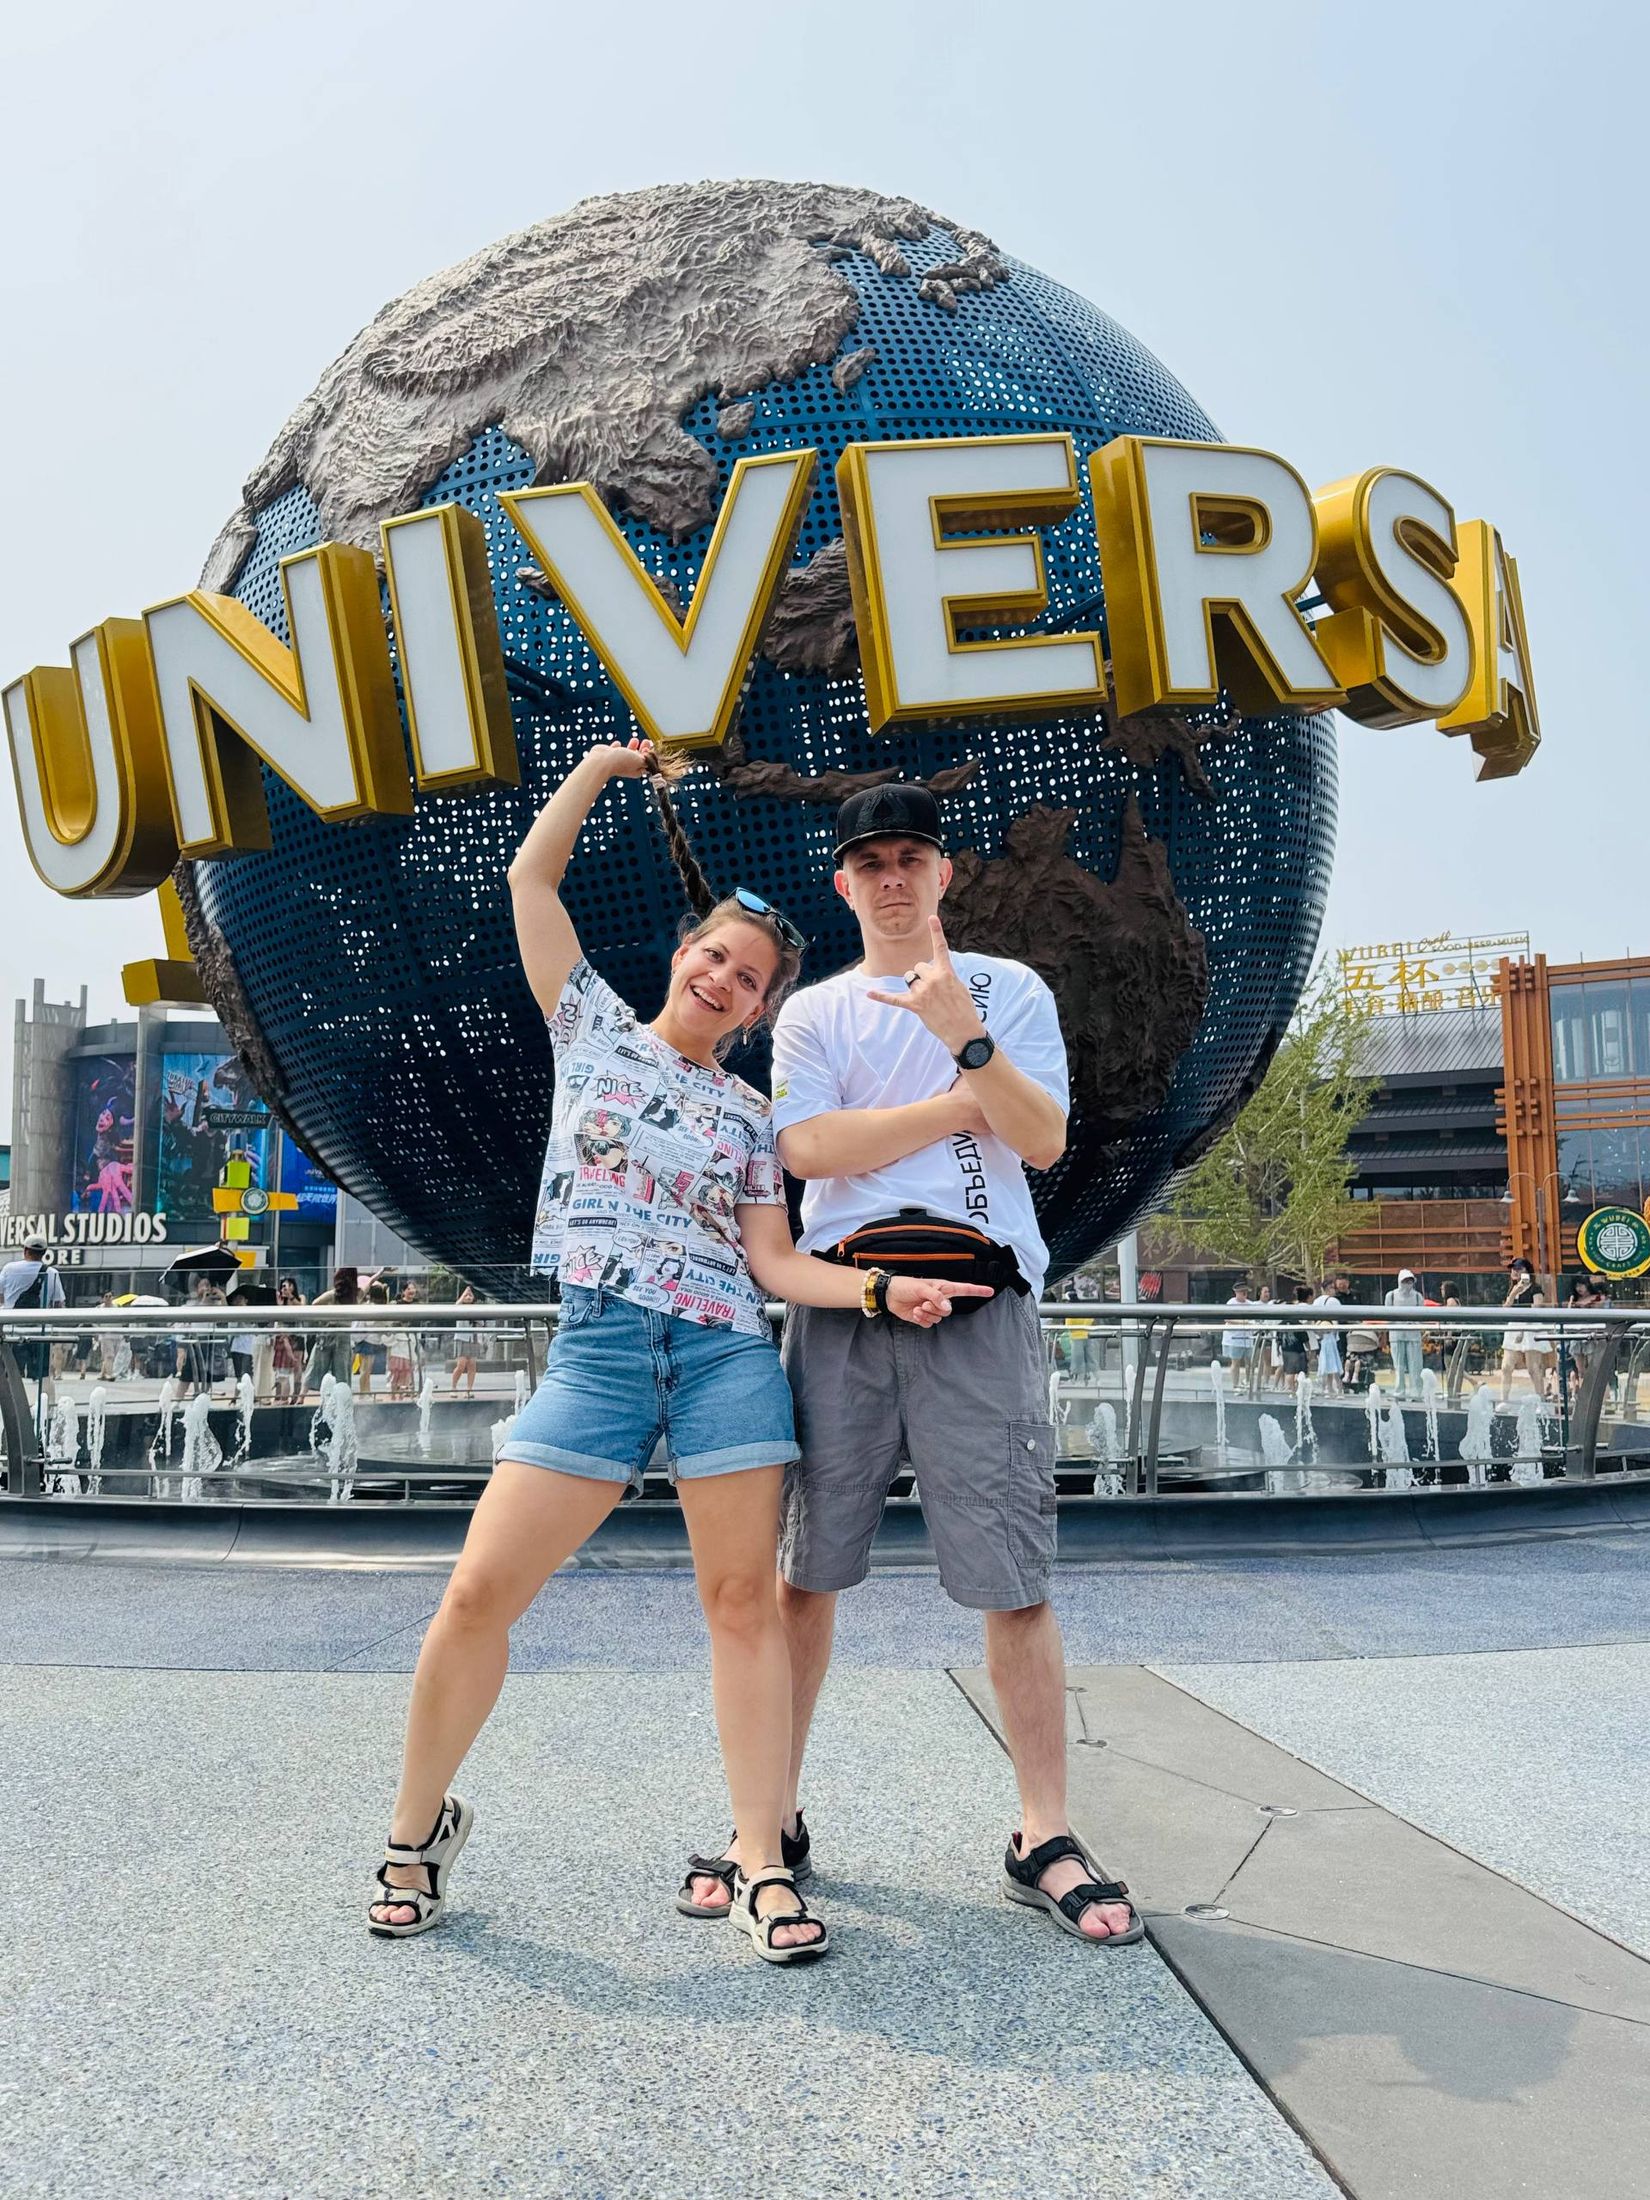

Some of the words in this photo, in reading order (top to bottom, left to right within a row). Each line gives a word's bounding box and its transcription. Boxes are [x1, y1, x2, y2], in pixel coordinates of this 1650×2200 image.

[1336, 941, 1412, 963] WUBEI
[1336, 959, 1440, 993] 五杯
[595, 1077, 645, 1098] NICE
[693, 1082, 727, 1099] CITY
[210, 1113, 266, 1124] CITYWALK
[572, 1198, 604, 1210] GIRL
[657, 1213, 692, 1229] CITY
[62, 1212, 168, 1244] STUDIOS
[43, 1249, 82, 1265] ORE
[533, 1253, 560, 1264] GIR
[685, 1269, 716, 1285] CITY
[718, 1281, 744, 1297] THE
[673, 1293, 736, 1320] TRAVELING
